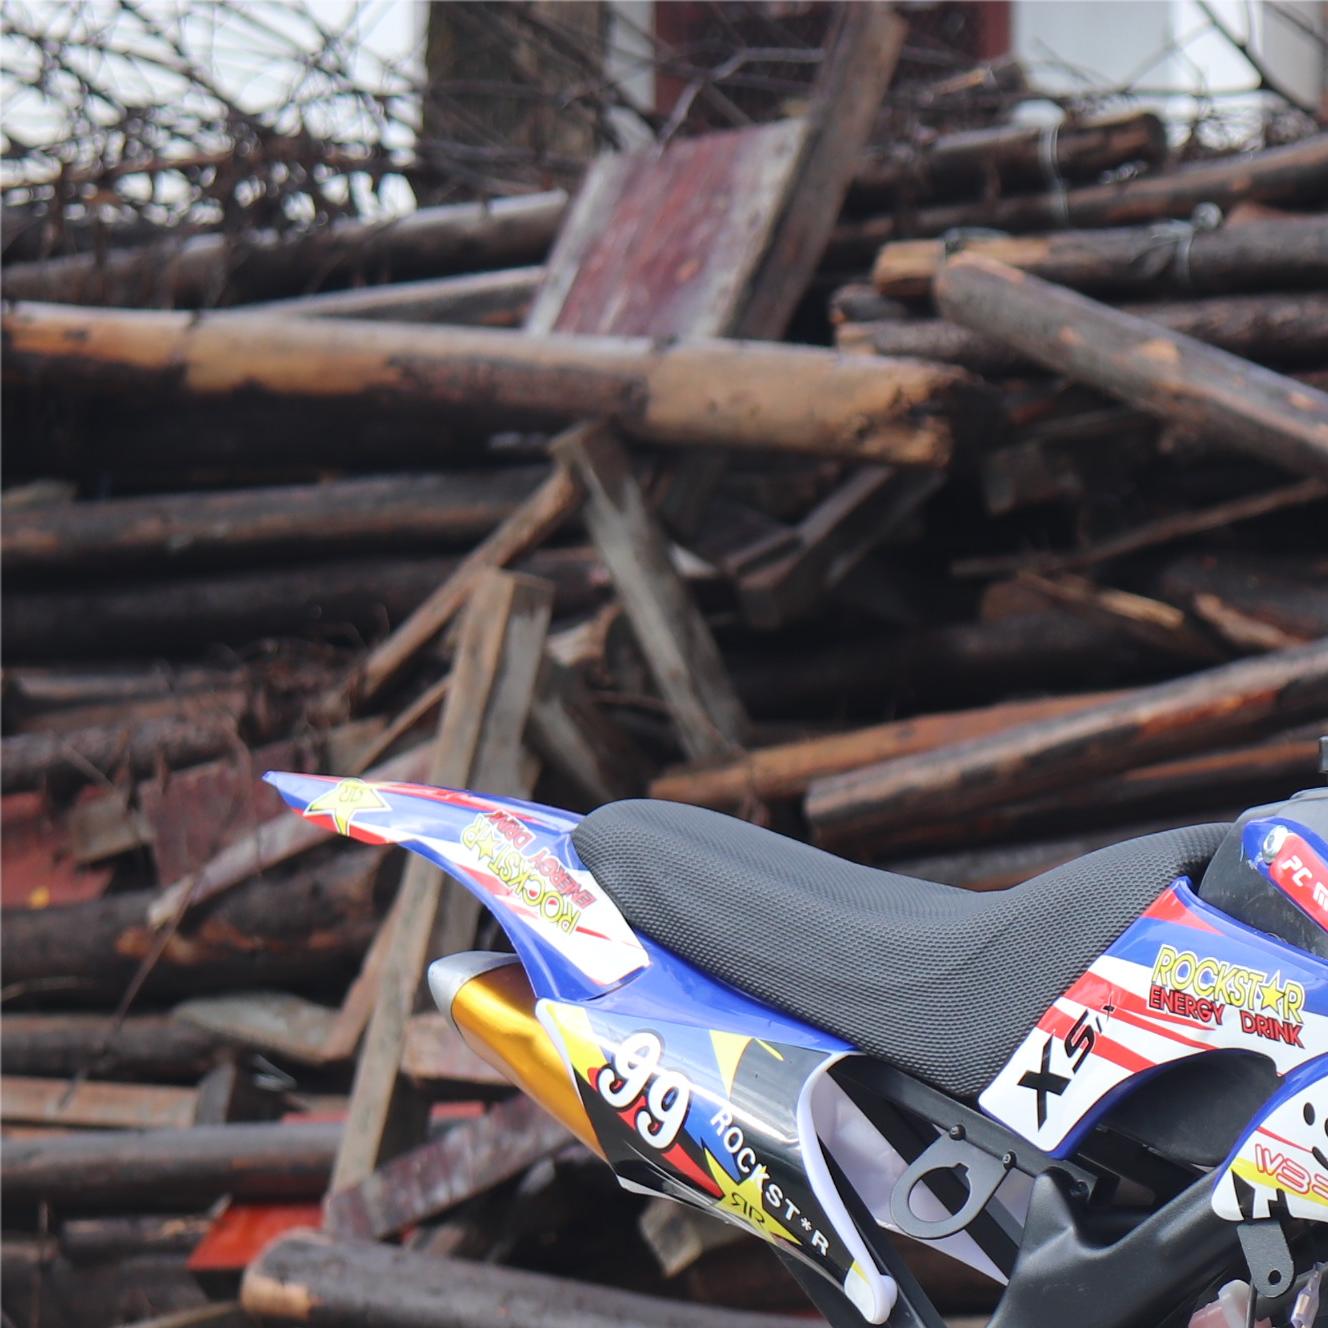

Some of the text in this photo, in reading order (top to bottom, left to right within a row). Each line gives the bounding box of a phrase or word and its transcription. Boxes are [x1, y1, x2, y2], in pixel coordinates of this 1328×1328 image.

[527, 848, 598, 910] ENERGY
[1149, 983, 1306, 1050] ENERGY DRINK
[596, 1029, 692, 1150] 99
